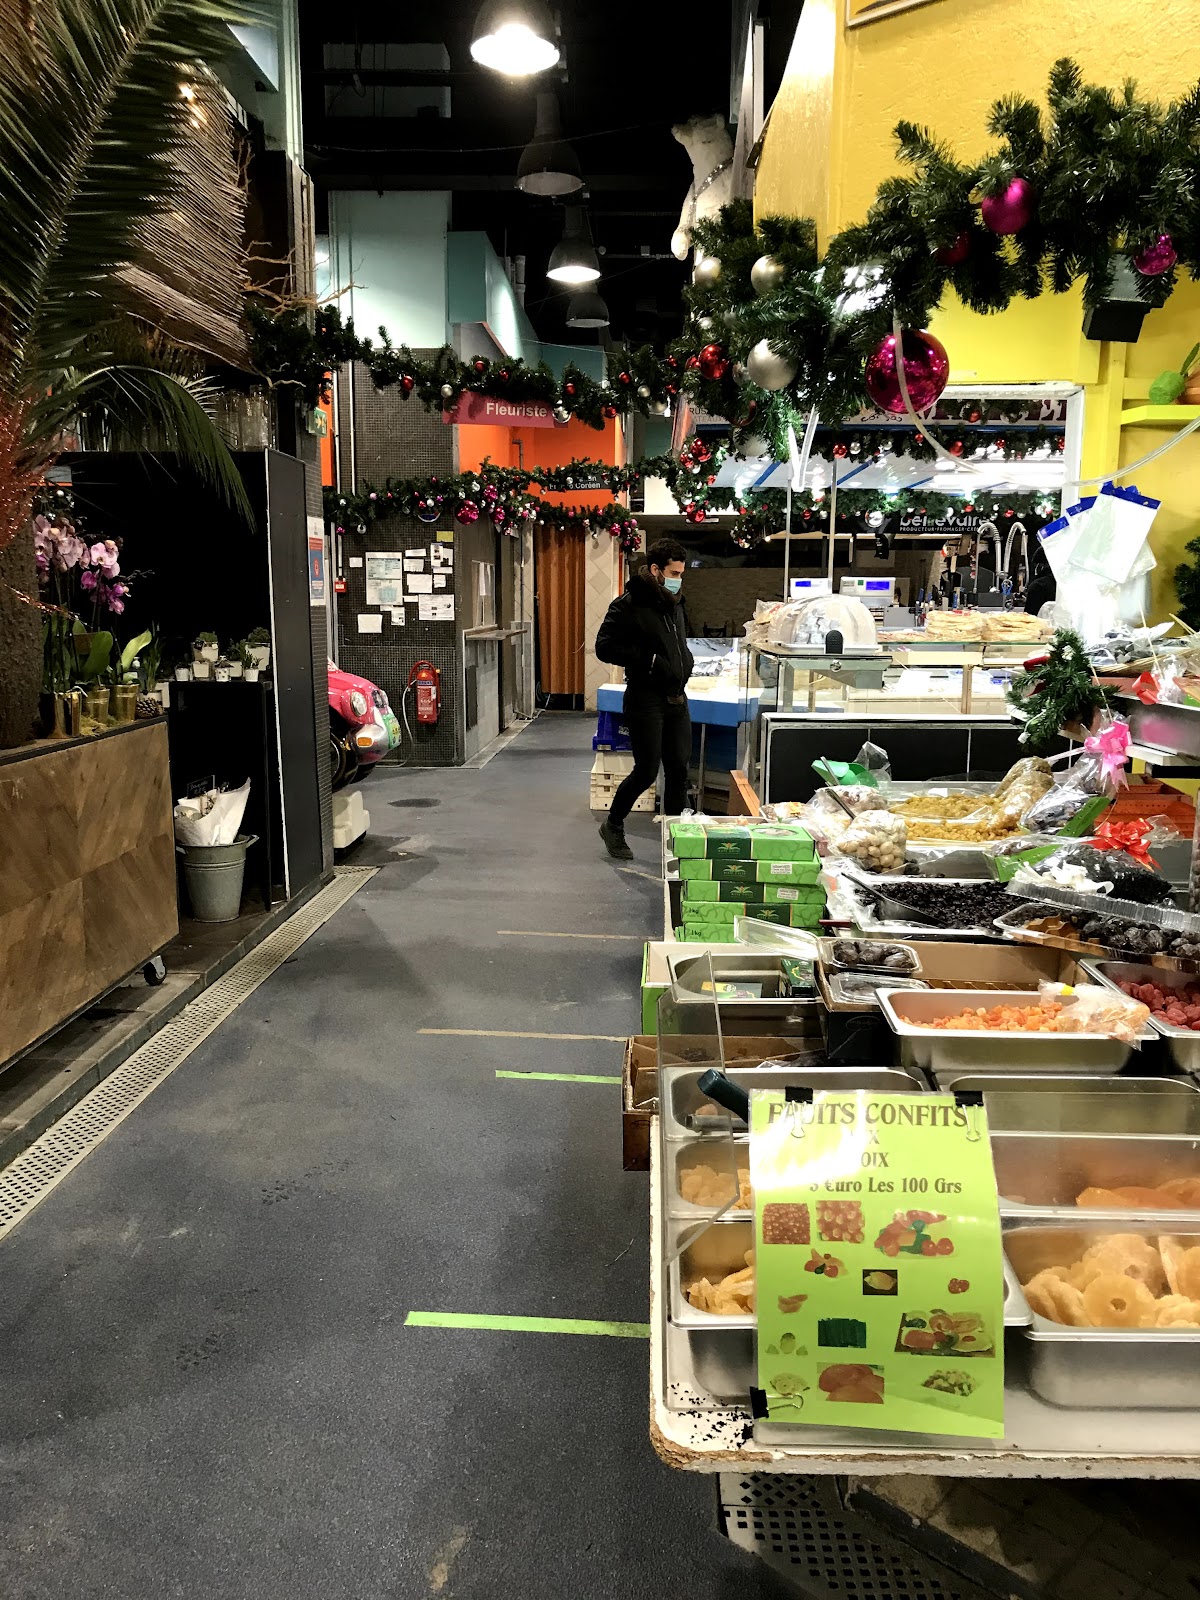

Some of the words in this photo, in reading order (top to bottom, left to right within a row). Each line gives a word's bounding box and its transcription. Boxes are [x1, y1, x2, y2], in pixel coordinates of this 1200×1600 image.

[486, 402, 547, 418] Fleuriste
[865, 1102, 968, 1127] CONFITS
[868, 1177, 894, 1193] Les
[902, 1177, 928, 1193] 100
[934, 1178, 962, 1194] Grs
